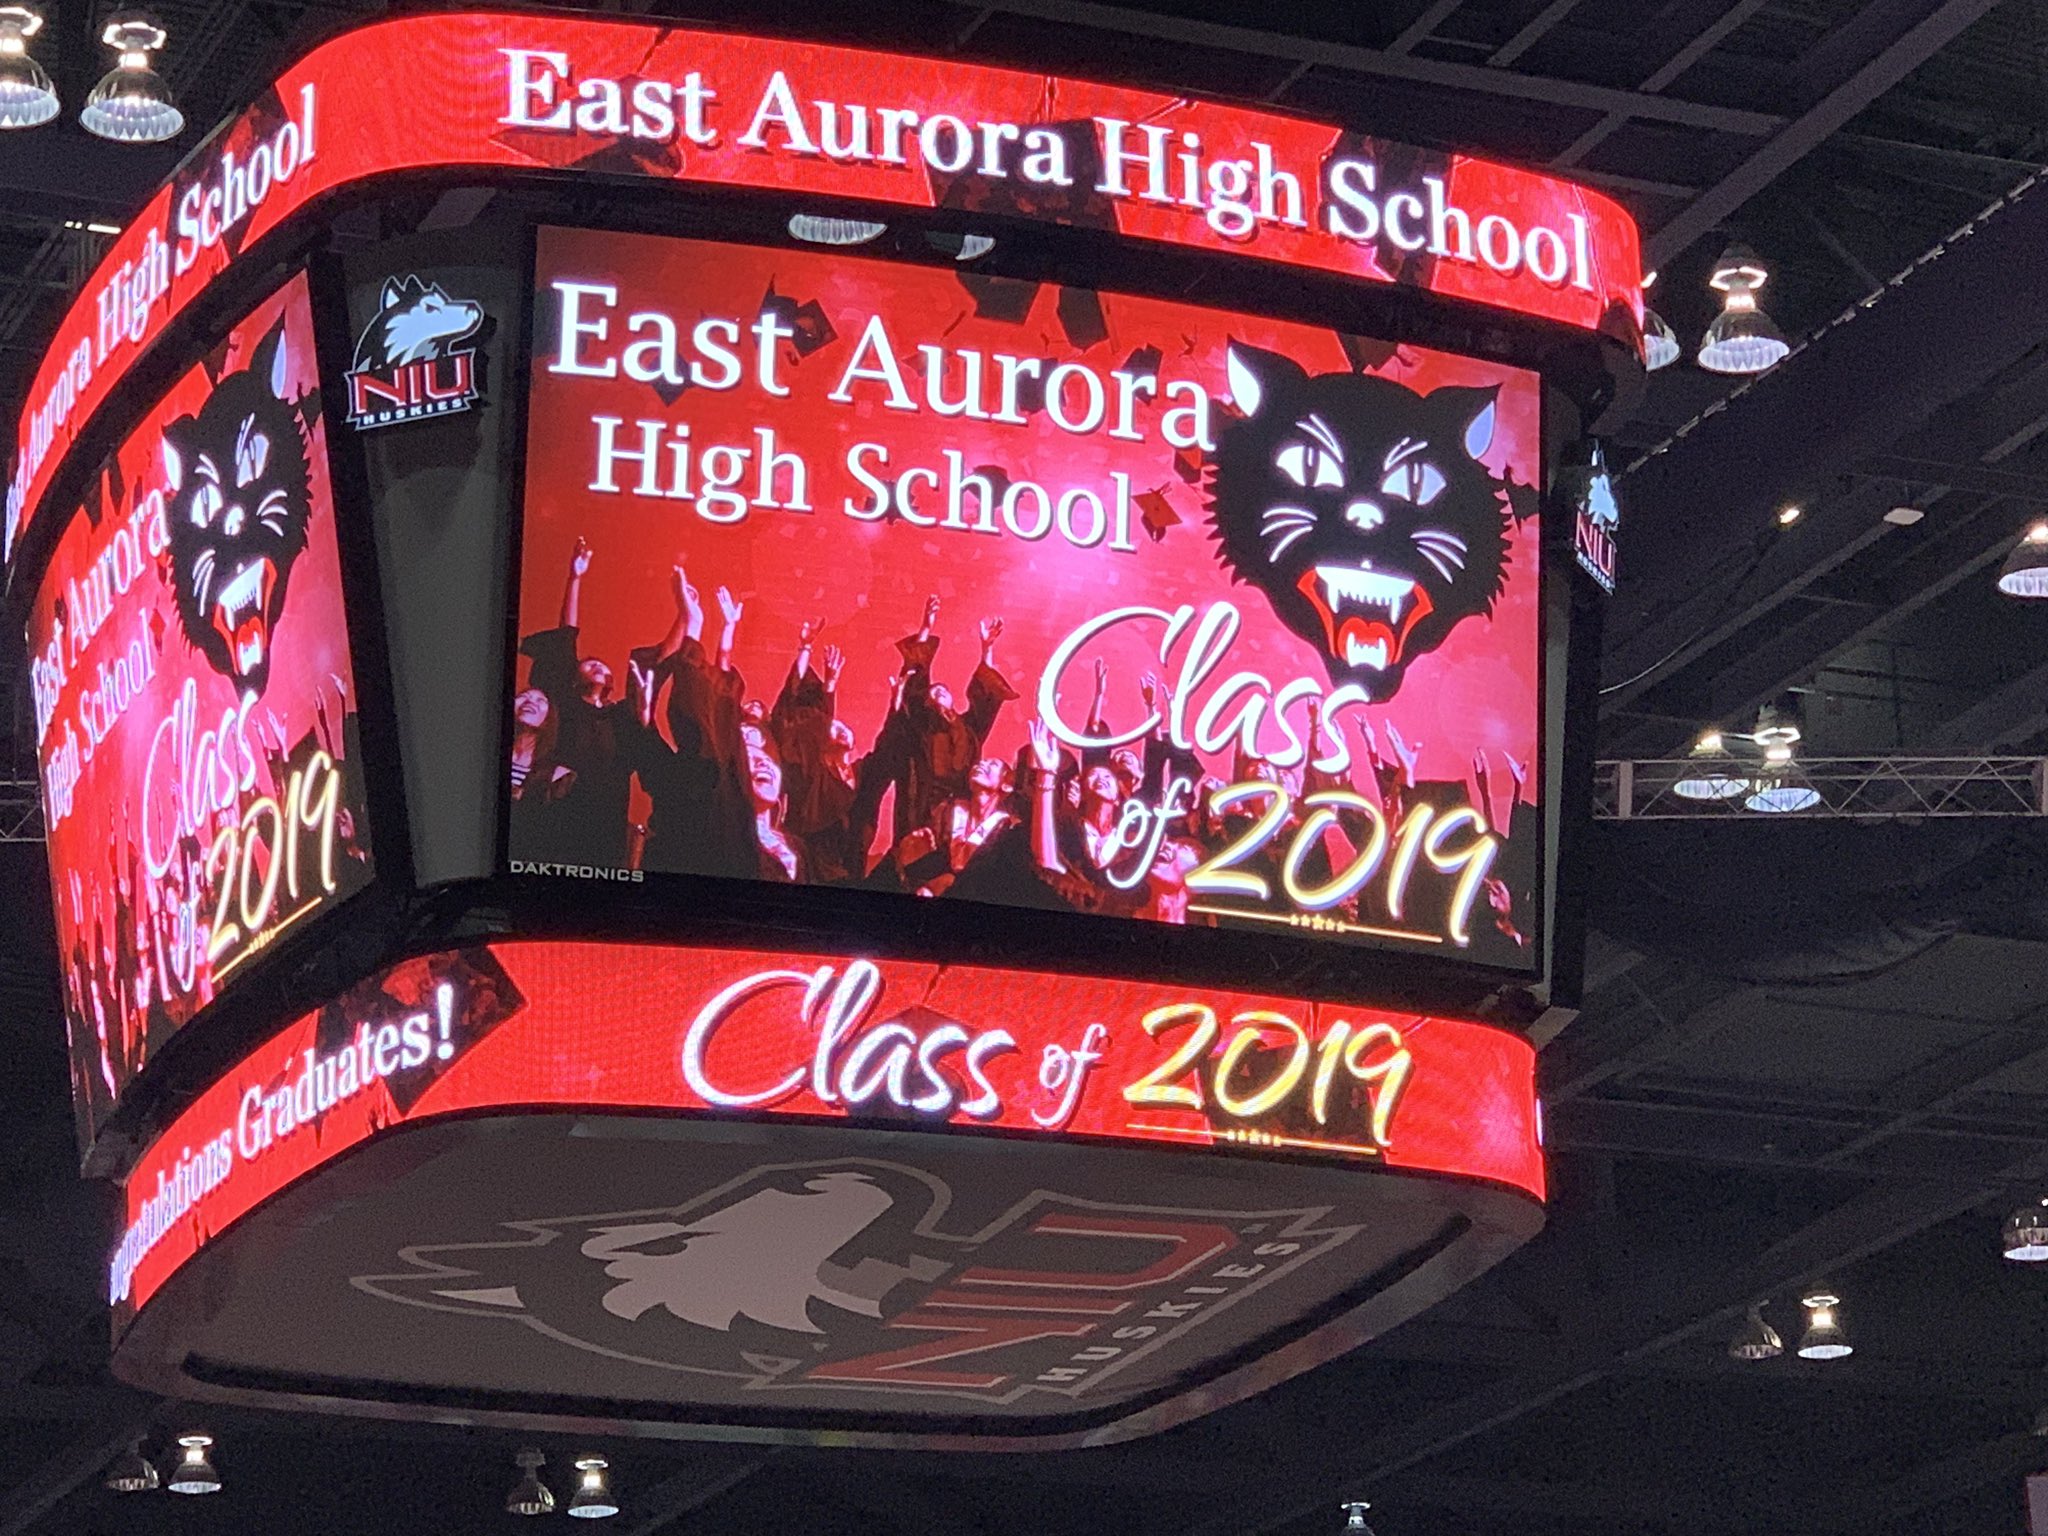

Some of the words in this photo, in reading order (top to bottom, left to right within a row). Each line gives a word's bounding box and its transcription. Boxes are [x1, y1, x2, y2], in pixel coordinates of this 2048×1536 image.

[96, 227, 170, 368] High
[174, 82, 316, 277] School
[498, 47, 716, 142] East
[738, 71, 1073, 186] Aurora
[1093, 116, 1307, 236] High
[1328, 158, 1594, 292] School
[353, 354, 471, 414] NIU
[363, 397, 463, 426] HUSKIES
[547, 280, 794, 397] East
[828, 314, 1217, 452] Aurora
[588, 416, 812, 523] High
[844, 442, 1135, 552] School
[68, 488, 172, 668] Aurora
[80, 607, 156, 763] School
[1037, 601, 1370, 774] Class
[142, 677, 258, 880] Class
[205, 750, 341, 962] 2019
[1106, 778, 1193, 890] of
[1184, 781, 1499, 947] 2019
[509, 861, 645, 883] DAKTRONICS
[238, 982, 456, 1160] Graduates!
[681, 959, 1017, 1119] Class
[1031, 1022, 1107, 1128] of
[1122, 1002, 1415, 1148] 2019
[807, 1211, 1240, 1387] NIU
[1034, 1241, 1300, 1383] HUSKIES
